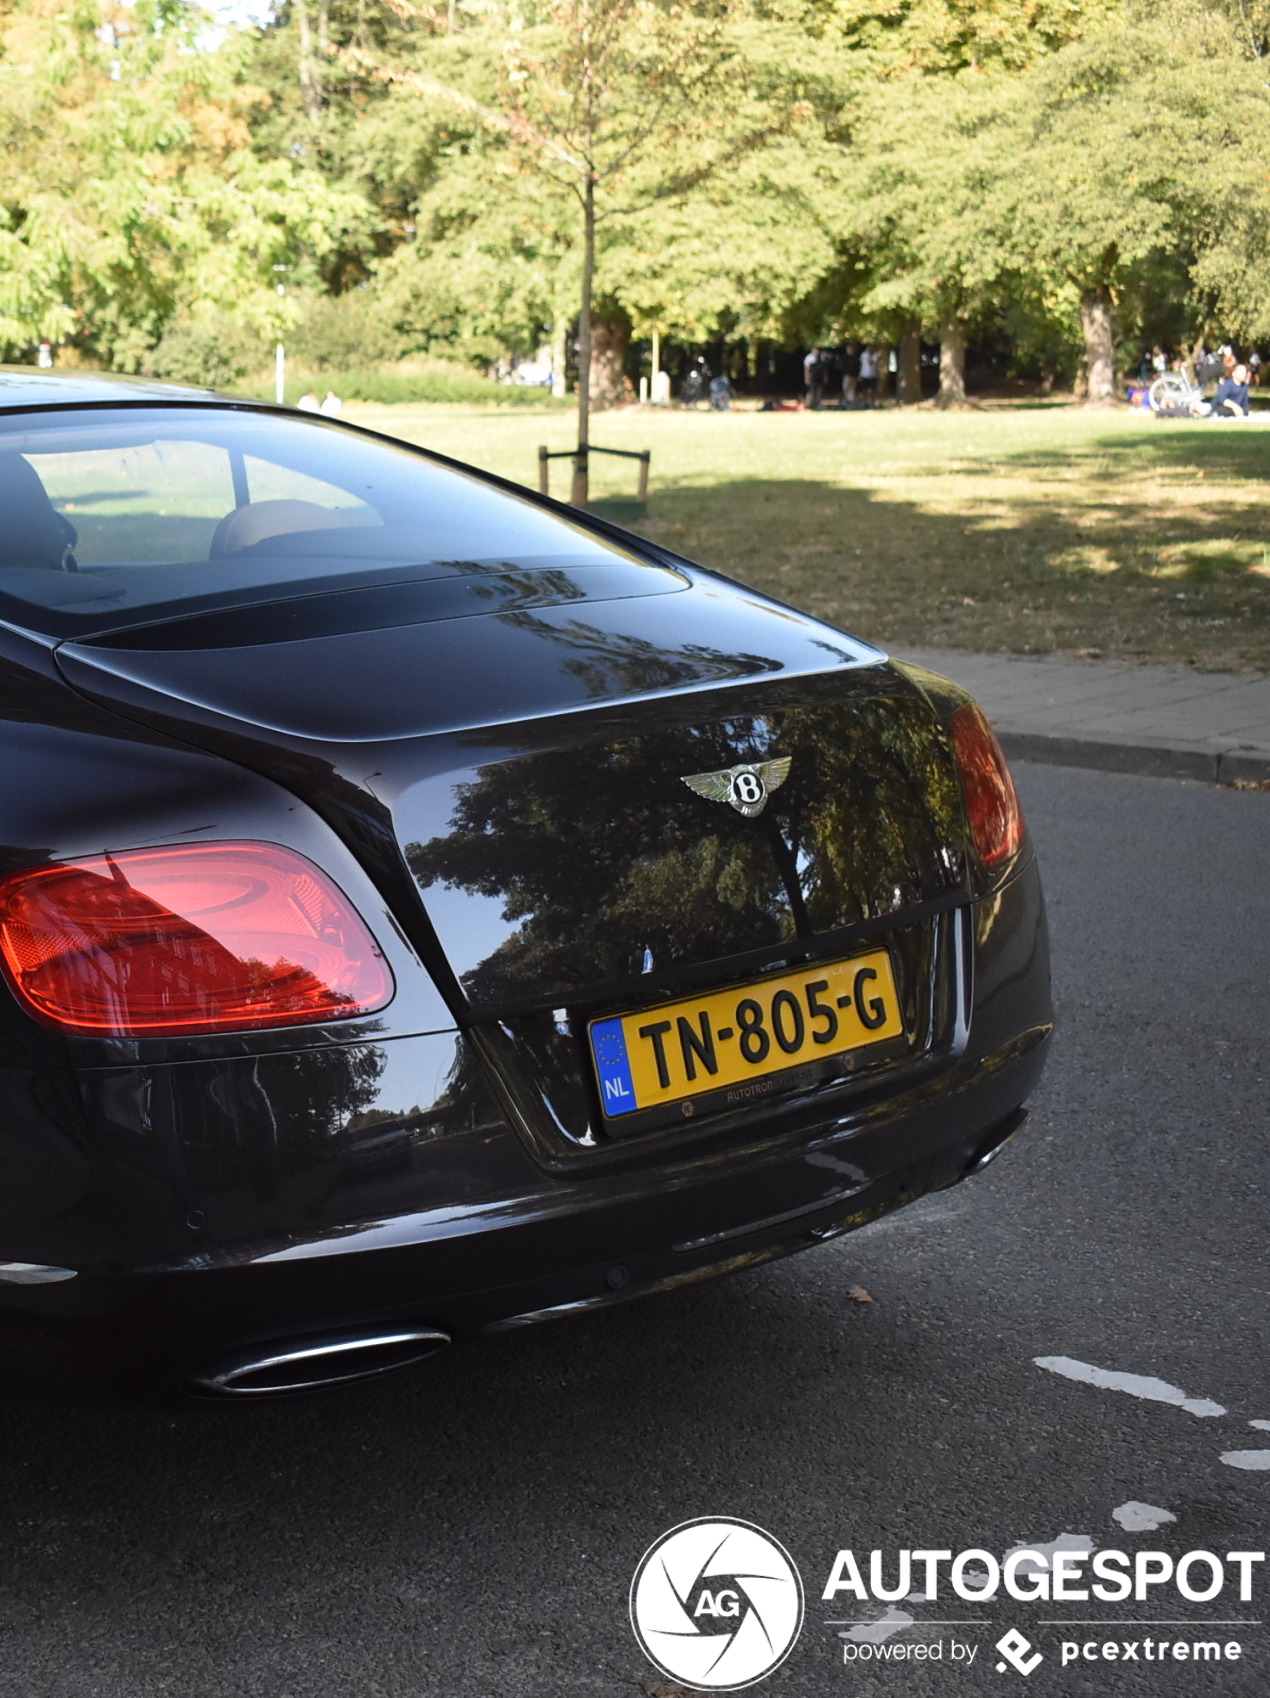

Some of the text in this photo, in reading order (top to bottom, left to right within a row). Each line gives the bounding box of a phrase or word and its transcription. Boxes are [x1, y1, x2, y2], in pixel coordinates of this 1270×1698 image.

[736, 774, 760, 802] B
[639, 968, 886, 1088] TN-805-G
[605, 1077, 630, 1099] NL
